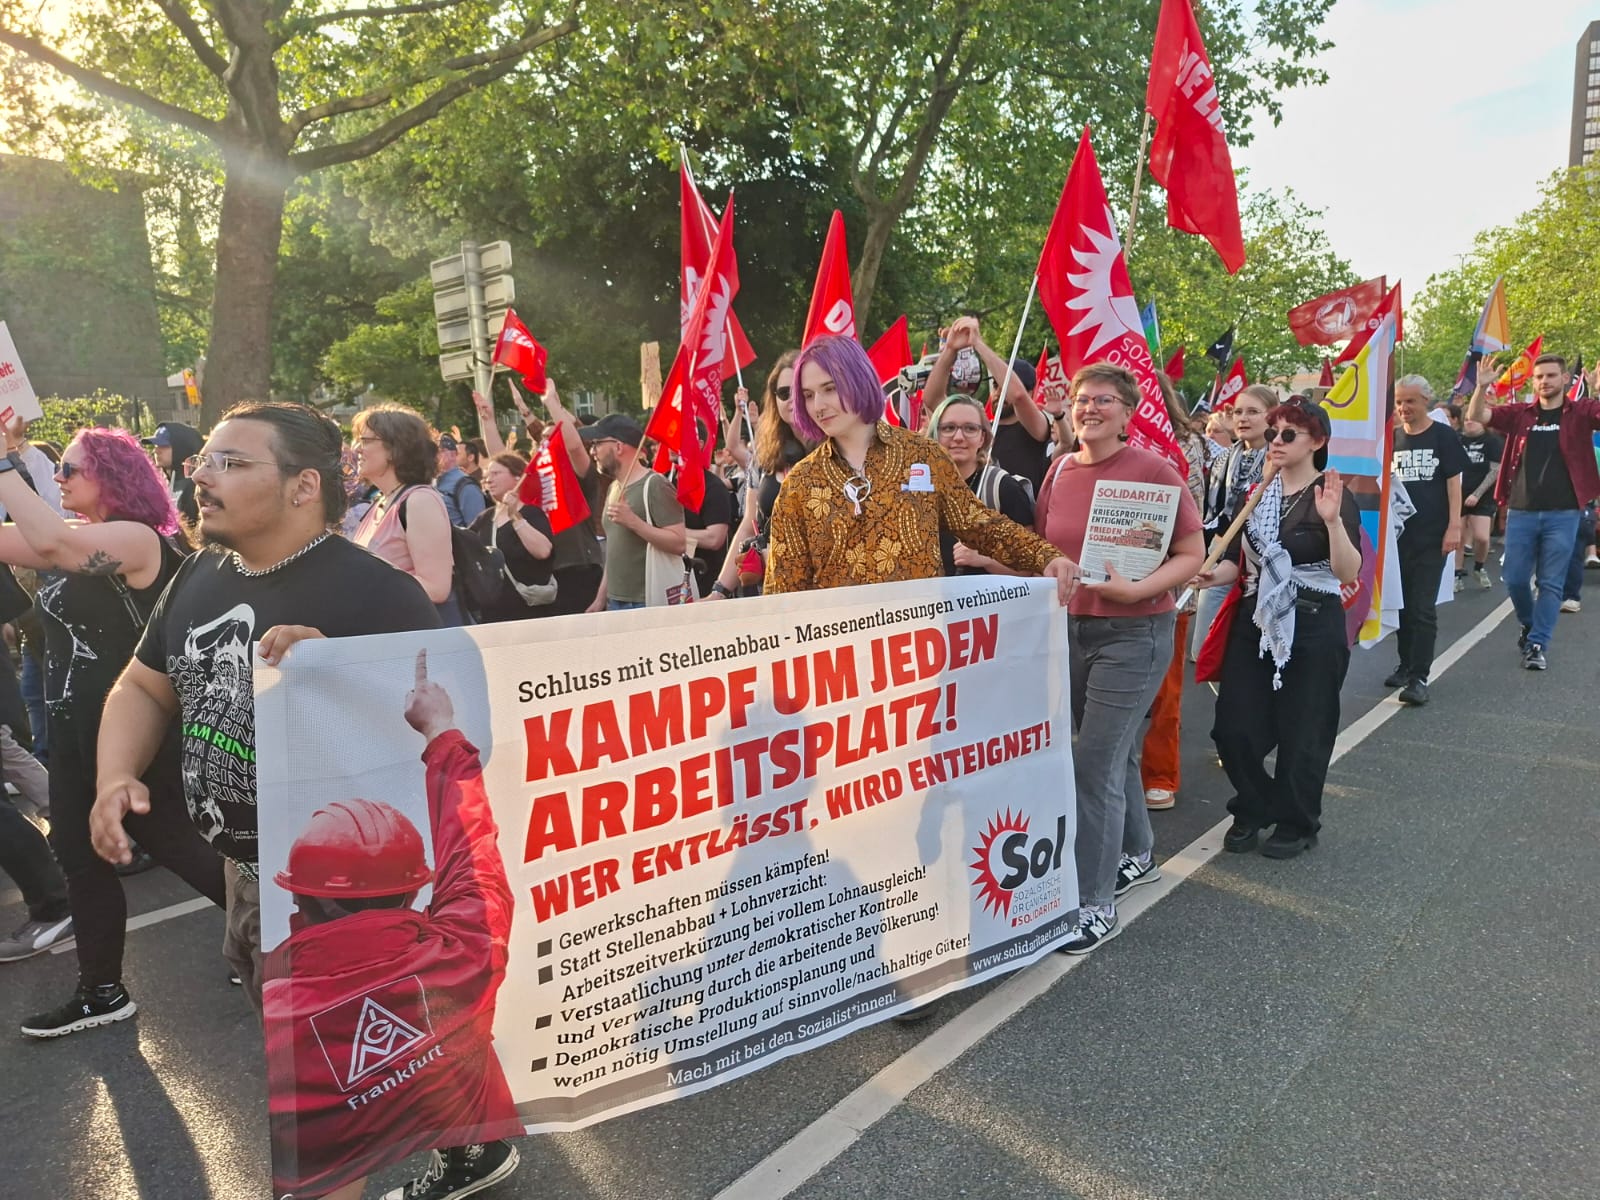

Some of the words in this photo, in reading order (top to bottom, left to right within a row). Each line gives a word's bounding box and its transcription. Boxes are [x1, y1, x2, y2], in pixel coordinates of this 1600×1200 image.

[1089, 525, 1122, 535] FRIEDEN
[1091, 516, 1134, 527] ENTEIGNEN!
[1092, 508, 1169, 523] KRIEGSPROFITEURE
[1097, 487, 1172, 504] SOLIDARITÄT
[518, 664, 612, 702] Schluss
[617, 658, 654, 682] mit
[659, 630, 780, 673] Stellenabbau
[795, 597, 954, 644] Massenentlassungen
[956, 583, 1031, 611] verhindern!
[189, 724, 211, 741] AM
[523, 667, 758, 782] KAMPF
[772, 644, 857, 715] UM
[869, 613, 999, 695] JEDEN
[206, 781, 258, 806] RIN
[523, 683, 957, 864] ARBEITSPLATZ!
[530, 858, 620, 923] WER
[825, 767, 903, 821] WIRD
[907, 721, 1051, 793] ENTEIGNET!
[559, 894, 701, 950] Gewerkschaften
[705, 875, 762, 902] müssen
[765, 849, 830, 882] kämpfen!
[1000, 815, 1066, 890] Sol
[557, 1025, 595, 1045] und
[602, 989, 705, 1033] Verwaltung
[708, 968, 751, 997] durch
[755, 957, 776, 978] die
[779, 934, 853, 968] arbeitende
[855, 903, 939, 941] Bevölkerung!
[560, 950, 601, 976] Statt
[606, 912, 716, 959] Stellenabbau
[720, 908, 728, 920] +
[731, 875, 827, 918] Lohnverzicht:
[560, 966, 704, 1023] Verstaatlichung
[706, 950, 745, 975] unter
[748, 911, 857, 957] demokratischer
[859, 890, 918, 918] Kontrolle
[561, 922, 750, 1003] Arbeitszeitverkürzung
[753, 910, 775, 933] bei
[777, 897, 825, 922] vollem
[828, 866, 927, 906] Lohnausgleich!
[972, 921, 1069, 971] www.solidaritaet.info
[553, 1065, 607, 1088] wenn
[611, 1044, 659, 1073] nötig
[664, 1014, 758, 1055] Umstellung
[761, 999, 784, 1021] auf
[788, 949, 933, 1011] sinnvolle/nachhaltige
[935, 934, 971, 955] Güter!
[554, 1013, 693, 1067] Demokratische
[698, 956, 847, 1024] Produktionsplanung
[850, 945, 876, 966] und
[347, 1044, 444, 1110] Frankfurt
[666, 1062, 713, 1087] Mach
[716, 1049, 742, 1072] mit
[744, 1037, 766, 1058] bei
[769, 1029, 794, 1049] den
